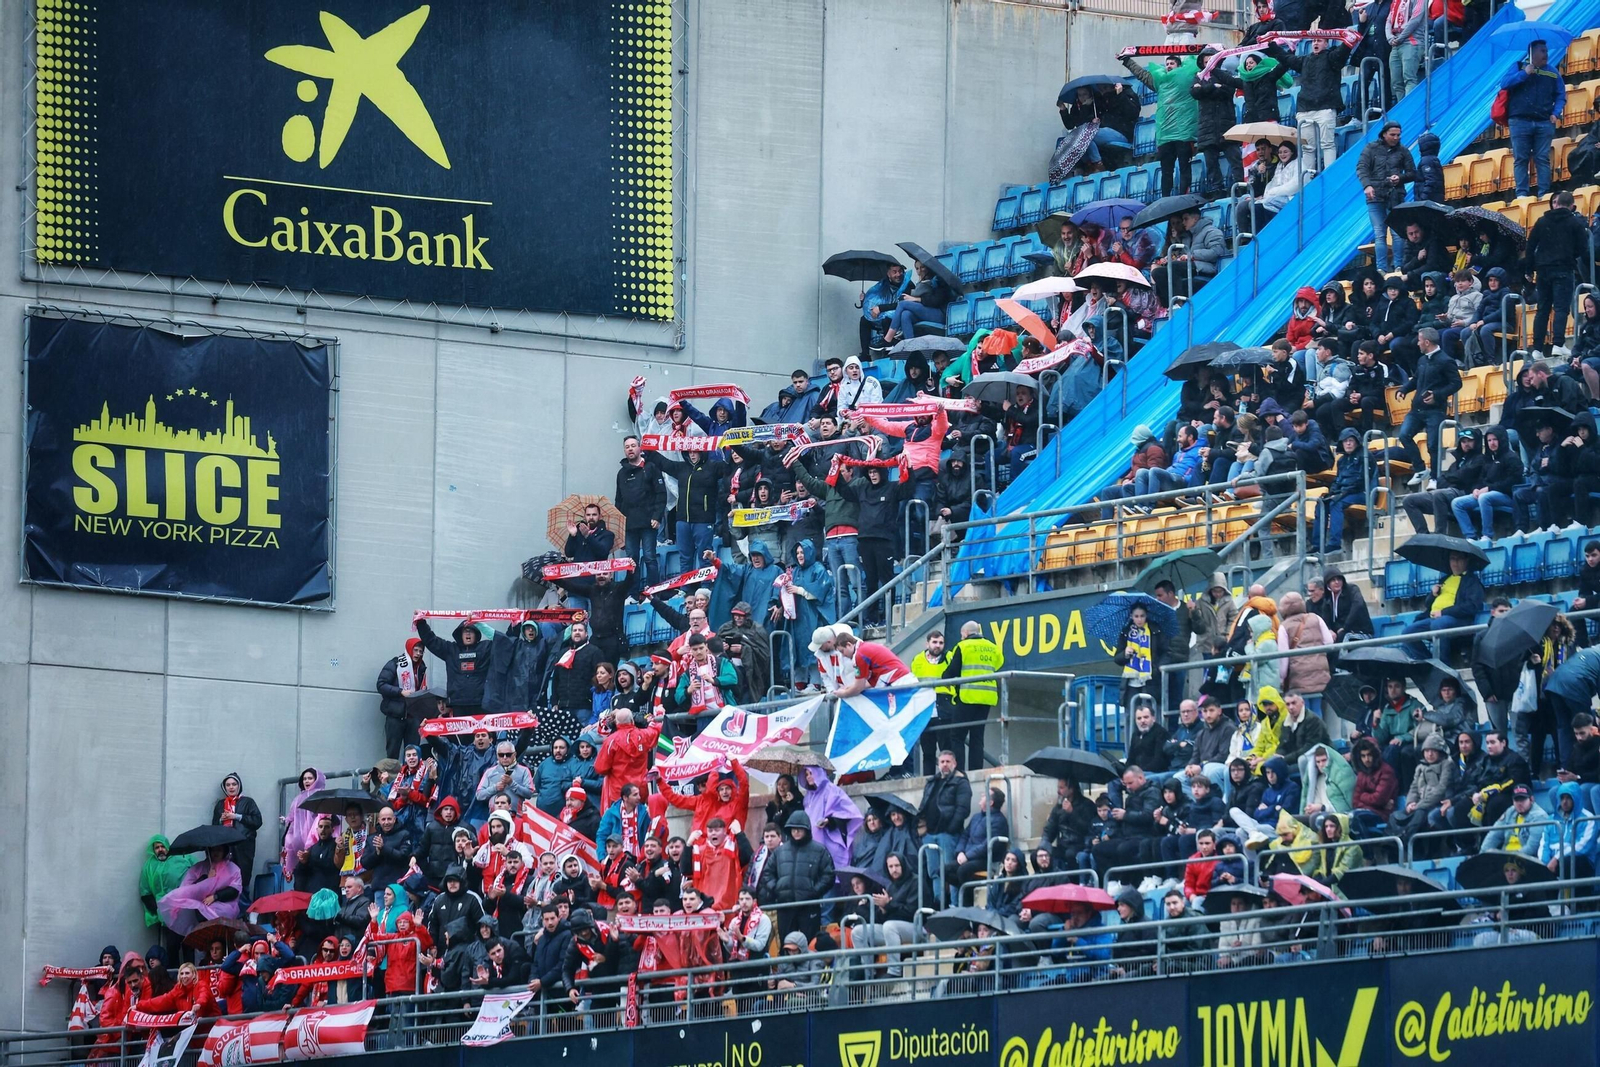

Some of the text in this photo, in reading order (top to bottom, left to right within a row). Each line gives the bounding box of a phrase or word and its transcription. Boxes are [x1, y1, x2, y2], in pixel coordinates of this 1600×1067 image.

[222, 188, 493, 270] CaixaBank
[72, 443, 281, 529] SLICE
[74, 513, 280, 549] NEW YORK PIZZA
[979, 609, 1087, 657] YUDA
[702, 739, 743, 754] LONDON
[731, 1041, 762, 1067] NO
[890, 1023, 989, 1064] Diputación
